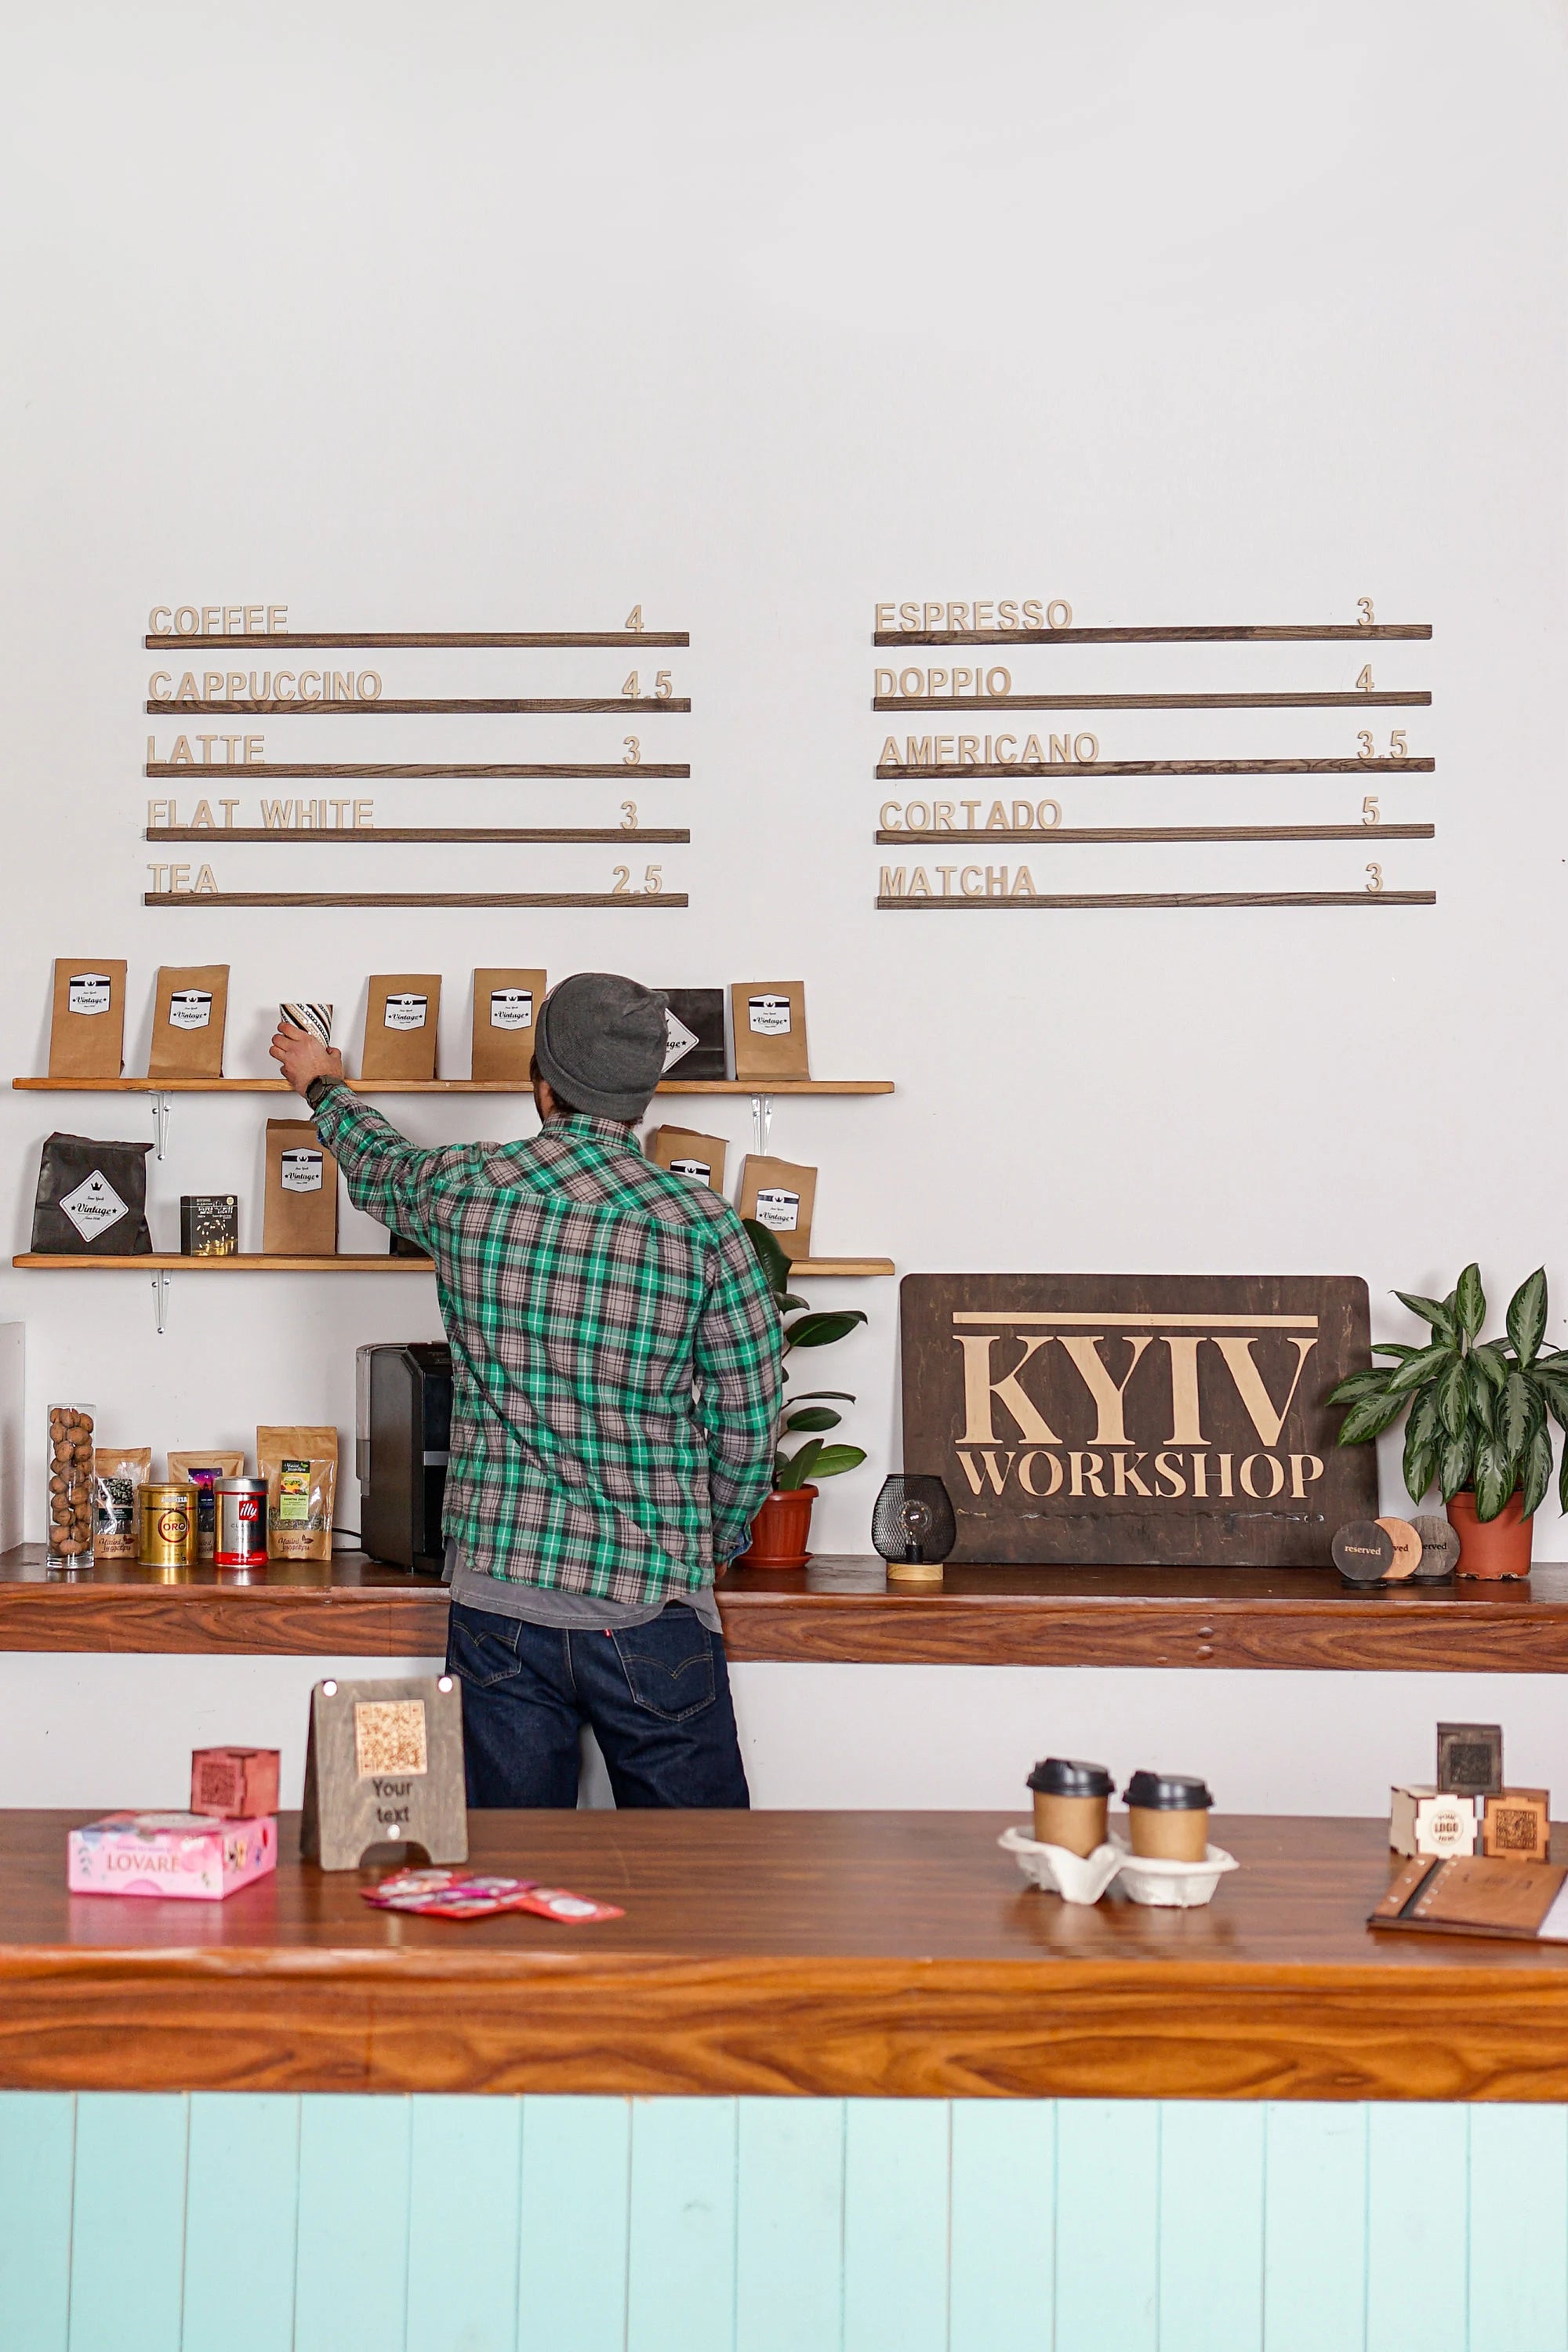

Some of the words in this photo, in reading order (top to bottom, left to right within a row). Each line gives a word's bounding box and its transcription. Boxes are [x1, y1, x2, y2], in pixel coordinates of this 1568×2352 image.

[149, 605, 288, 635] COFFEE
[626, 604, 644, 633] 4
[876, 600, 1073, 632] ESPRESSO
[1357, 597, 1375, 626] 3
[149, 671, 383, 700] CAPPUCCINO
[622, 671, 673, 699] 4.5
[876, 666, 1011, 697] DOPPIO
[1356, 665, 1375, 692] 4
[147, 735, 265, 764] LATTE
[623, 735, 641, 765] 3
[880, 732, 1100, 764] AMERICANO
[1357, 730, 1409, 759] 3.5
[147, 800, 240, 828] FLAT
[261, 800, 374, 828] WHITE
[620, 800, 638, 829] 3
[880, 799, 1062, 831] CORTADO
[1363, 797, 1380, 826] 5
[148, 864, 219, 893] TEA
[612, 866, 663, 894] 2.5
[880, 866, 1036, 896] MATCHA
[1367, 863, 1384, 892] 3
[76, 996, 103, 1004] Vintage
[177, 1011, 203, 1020] Vintage
[498, 1011, 524, 1020] Vintage
[757, 1017, 783, 1025] Vintage
[289, 1172, 315, 1181] Vintage
[77, 1203, 111, 1217] Vintage
[763, 1211, 789, 1222] Vintage
[952, 1334, 1318, 1447] KYIV
[955, 1450, 1324, 1499] WORKSHOP
[240, 1503, 257, 1519] illy
[1344, 1545, 1381, 1556] reserved
[372, 1777, 413, 1797] Your
[376, 1806, 409, 1824] text
[1434, 1822, 1458, 1833] LOGO
